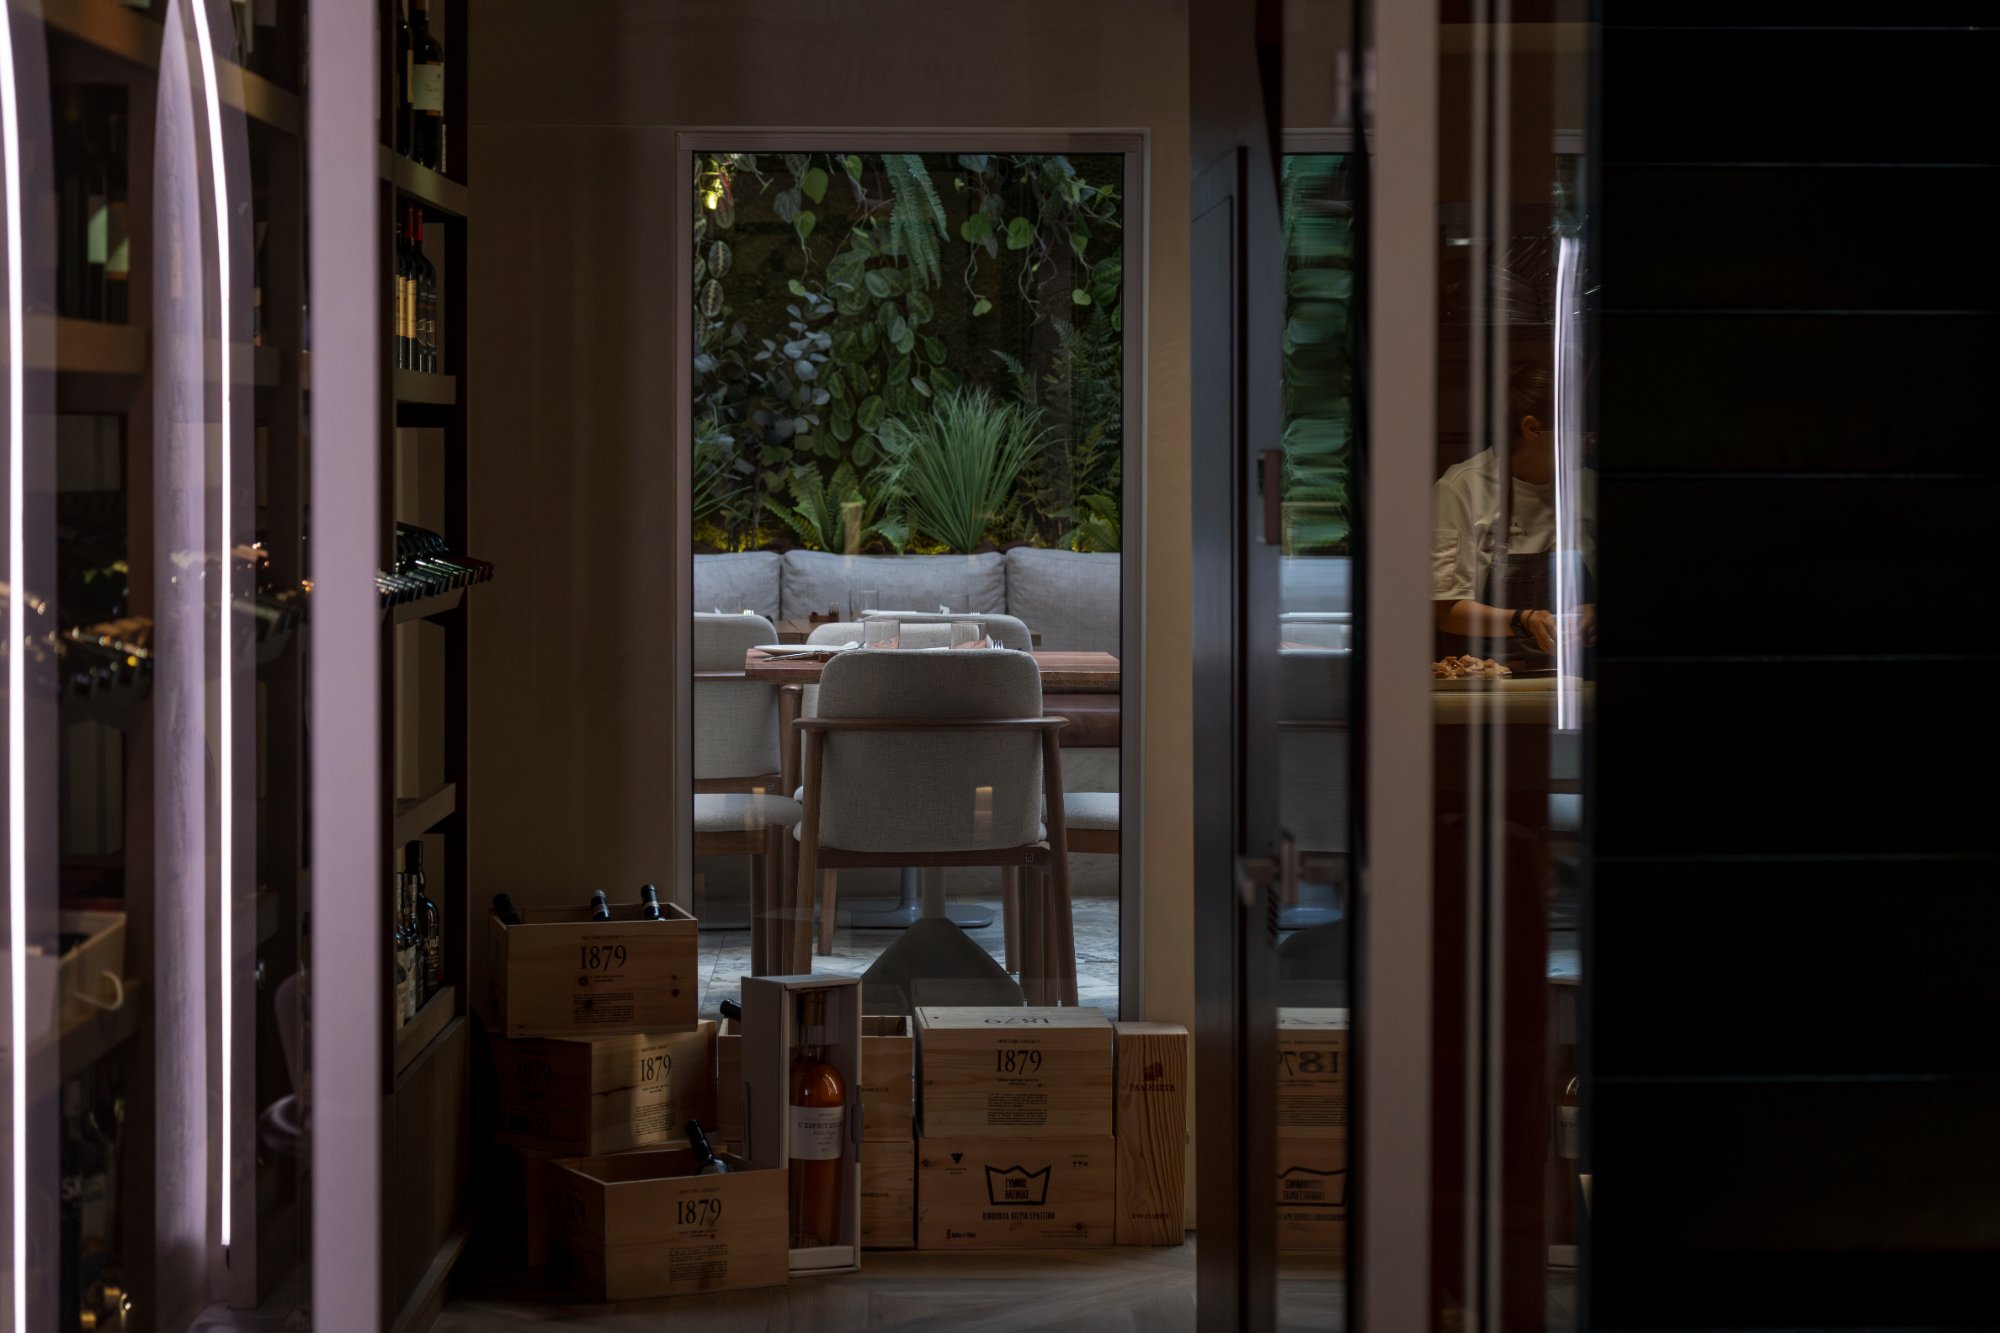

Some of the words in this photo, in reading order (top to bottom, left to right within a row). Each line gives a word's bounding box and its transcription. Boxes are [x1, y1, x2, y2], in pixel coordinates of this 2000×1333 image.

[579, 944, 627, 971] 1879
[640, 1054, 672, 1082] 1879
[995, 1049, 1042, 1075] 1879
[676, 1198, 722, 1226] 1879
